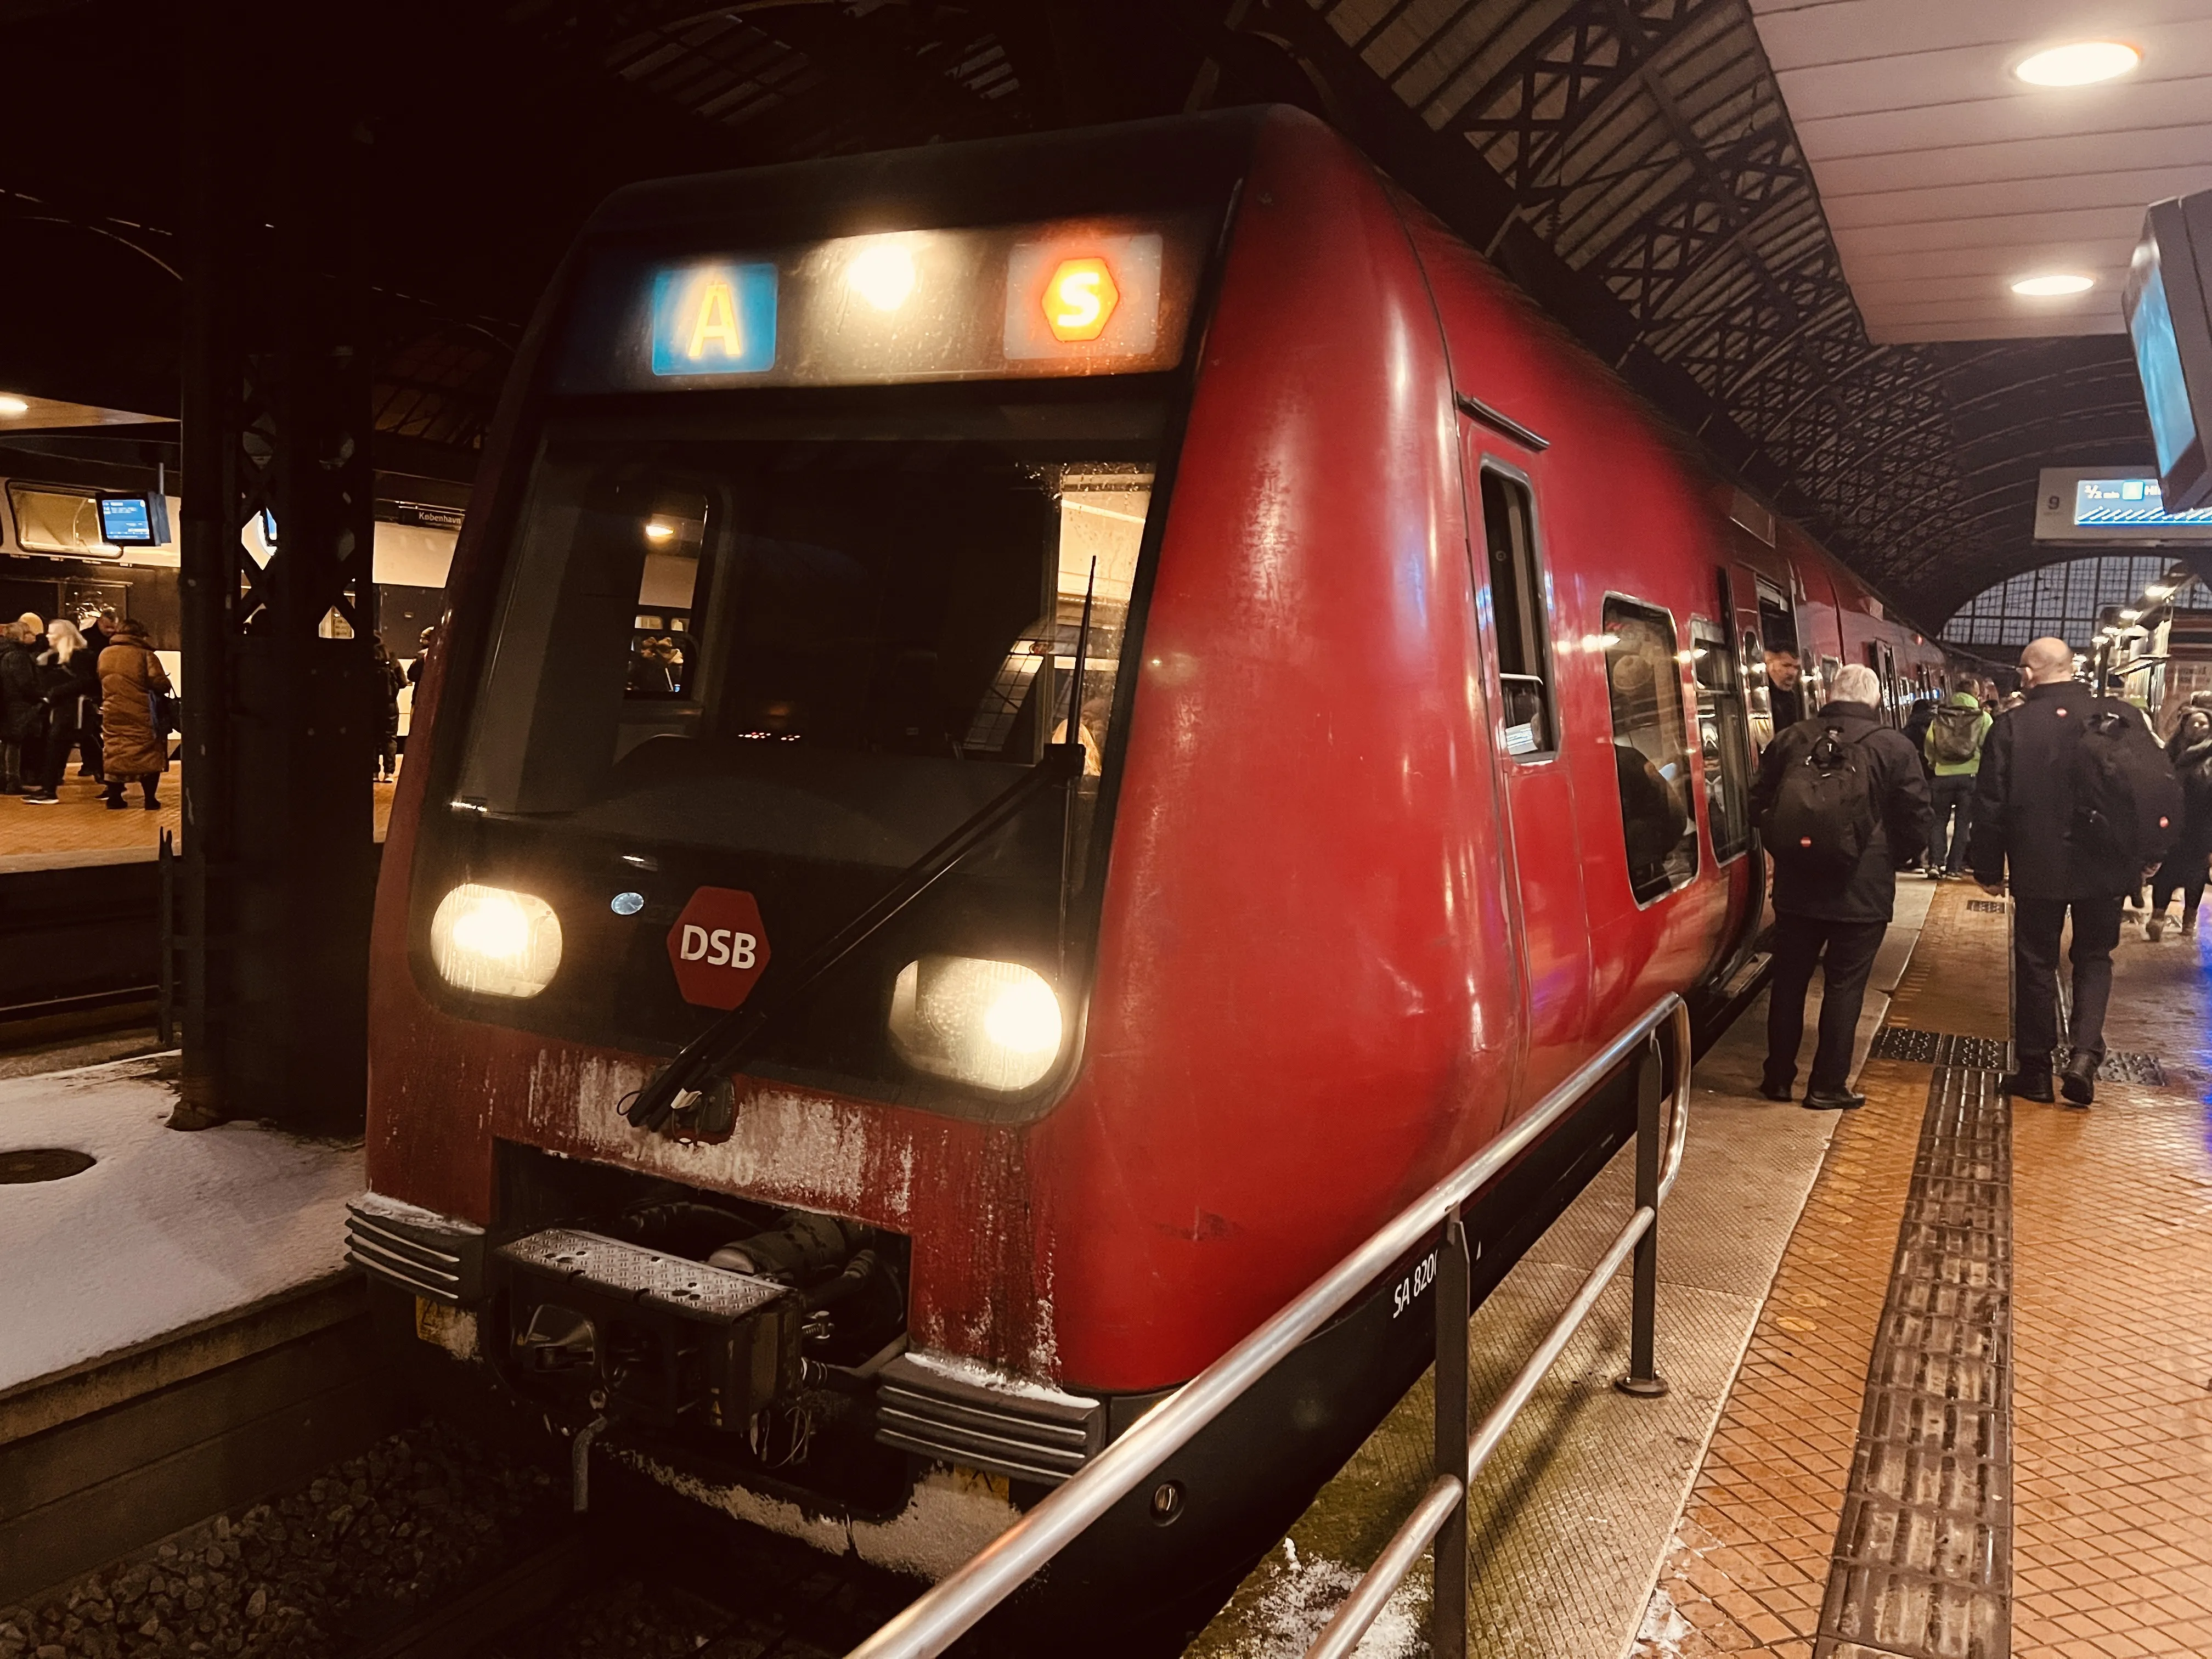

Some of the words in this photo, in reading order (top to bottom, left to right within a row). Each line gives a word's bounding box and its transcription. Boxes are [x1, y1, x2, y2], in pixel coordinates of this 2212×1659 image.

[688, 283, 741, 358] A
[1057, 272, 1101, 328] S
[419, 512, 461, 524] København
[2048, 495, 2059, 510] 9
[680, 924, 757, 969] DSB
[1393, 1277, 1410, 1319] SA
[1413, 1249, 1438, 1297] 820
